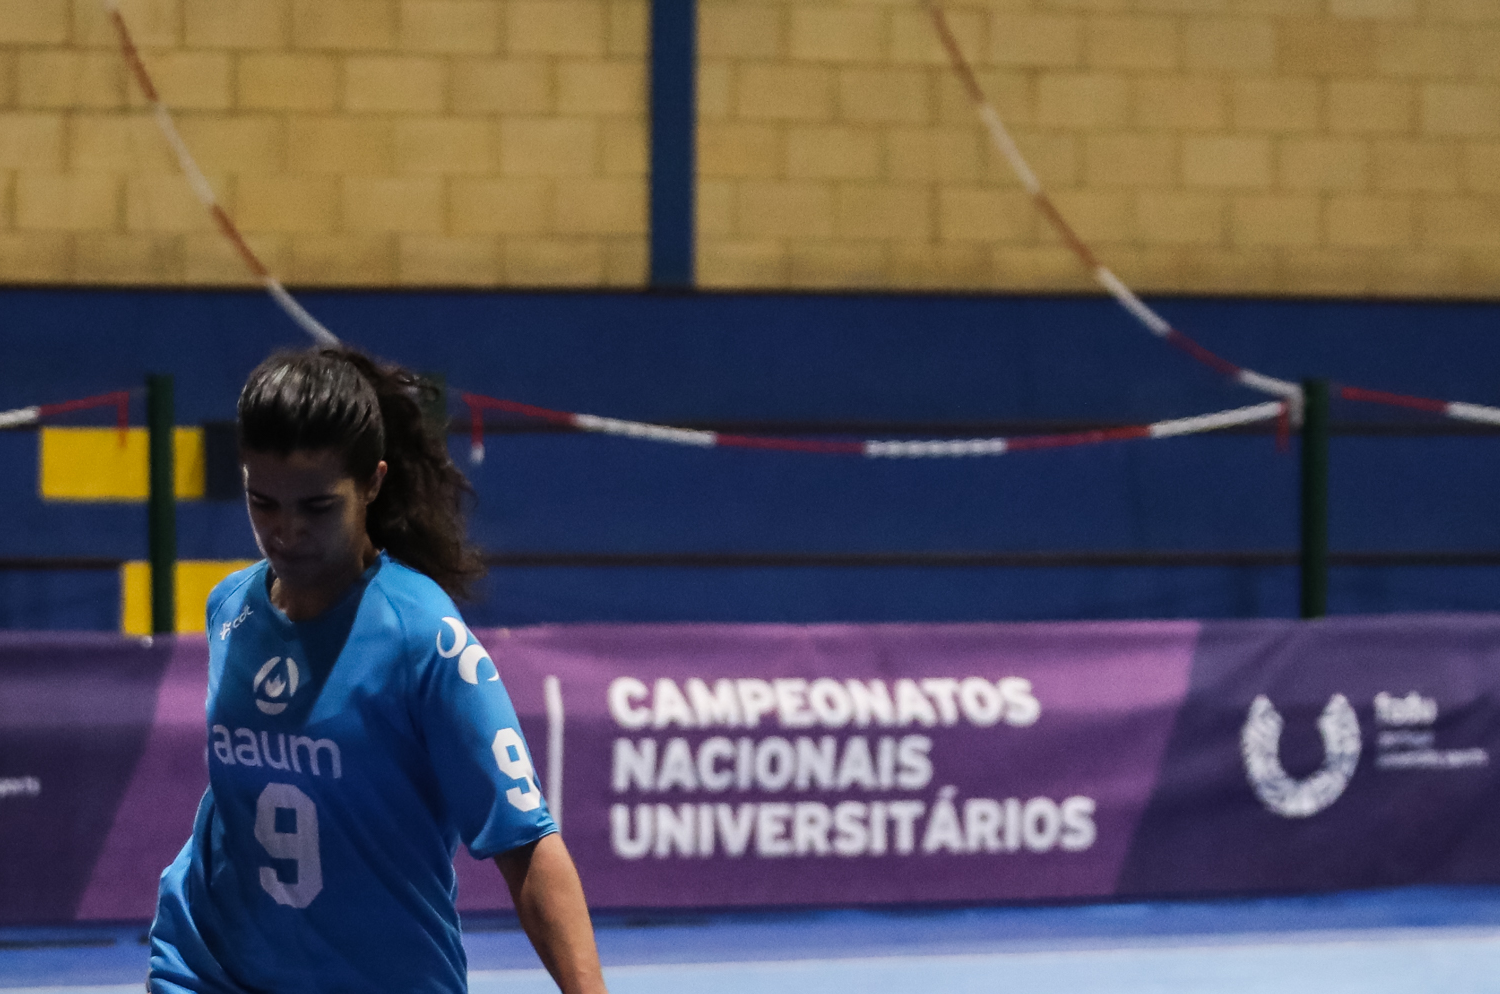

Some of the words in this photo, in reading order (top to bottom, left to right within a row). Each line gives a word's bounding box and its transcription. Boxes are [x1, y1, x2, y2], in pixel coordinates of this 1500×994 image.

[607, 675, 1041, 730] CAMPEONATOS
[213, 724, 342, 779] aaum
[491, 727, 541, 812] 9
[610, 734, 933, 793] NACIONAIS
[254, 782, 323, 909] 9
[610, 784, 1097, 859] UNIVERSITÁRIOS
